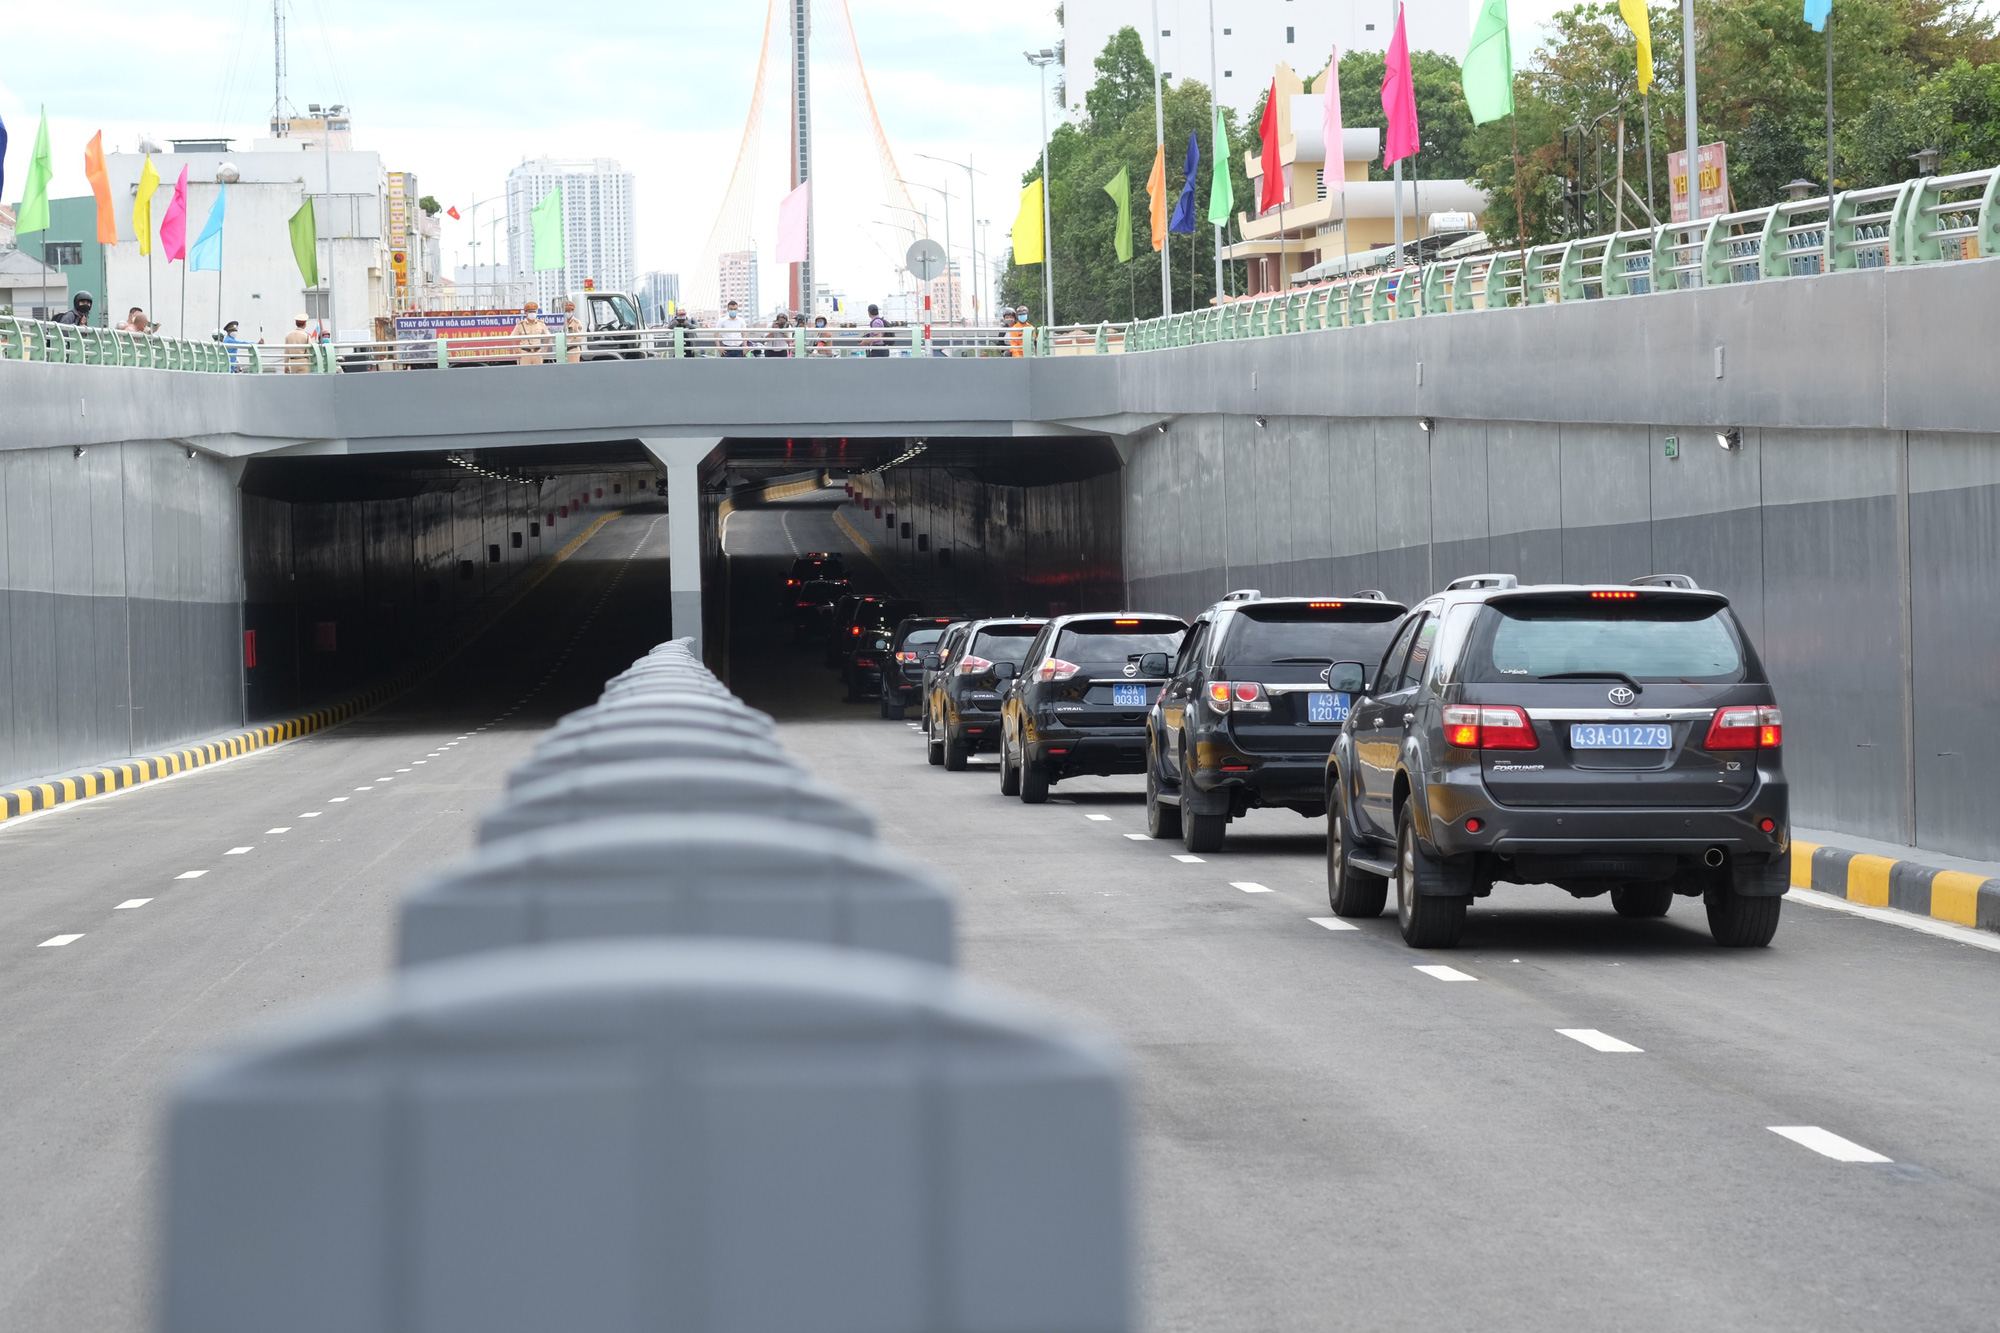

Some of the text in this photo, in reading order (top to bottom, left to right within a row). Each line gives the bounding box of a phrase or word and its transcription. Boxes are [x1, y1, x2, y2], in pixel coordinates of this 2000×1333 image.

[400, 320, 416, 328] THAY
[431, 318, 444, 327] VĂN
[445, 318, 459, 327] HÓA
[460, 319, 476, 327] GIAO
[1122, 686, 1138, 695] 43A
[1115, 695, 1144, 704] 003.91
[1319, 694, 1340, 707] 43A
[1312, 707, 1349, 720] 120.79
[1575, 727, 1667, 745] 43A-012.79
[1492, 764, 1545, 772] FORTUNER
